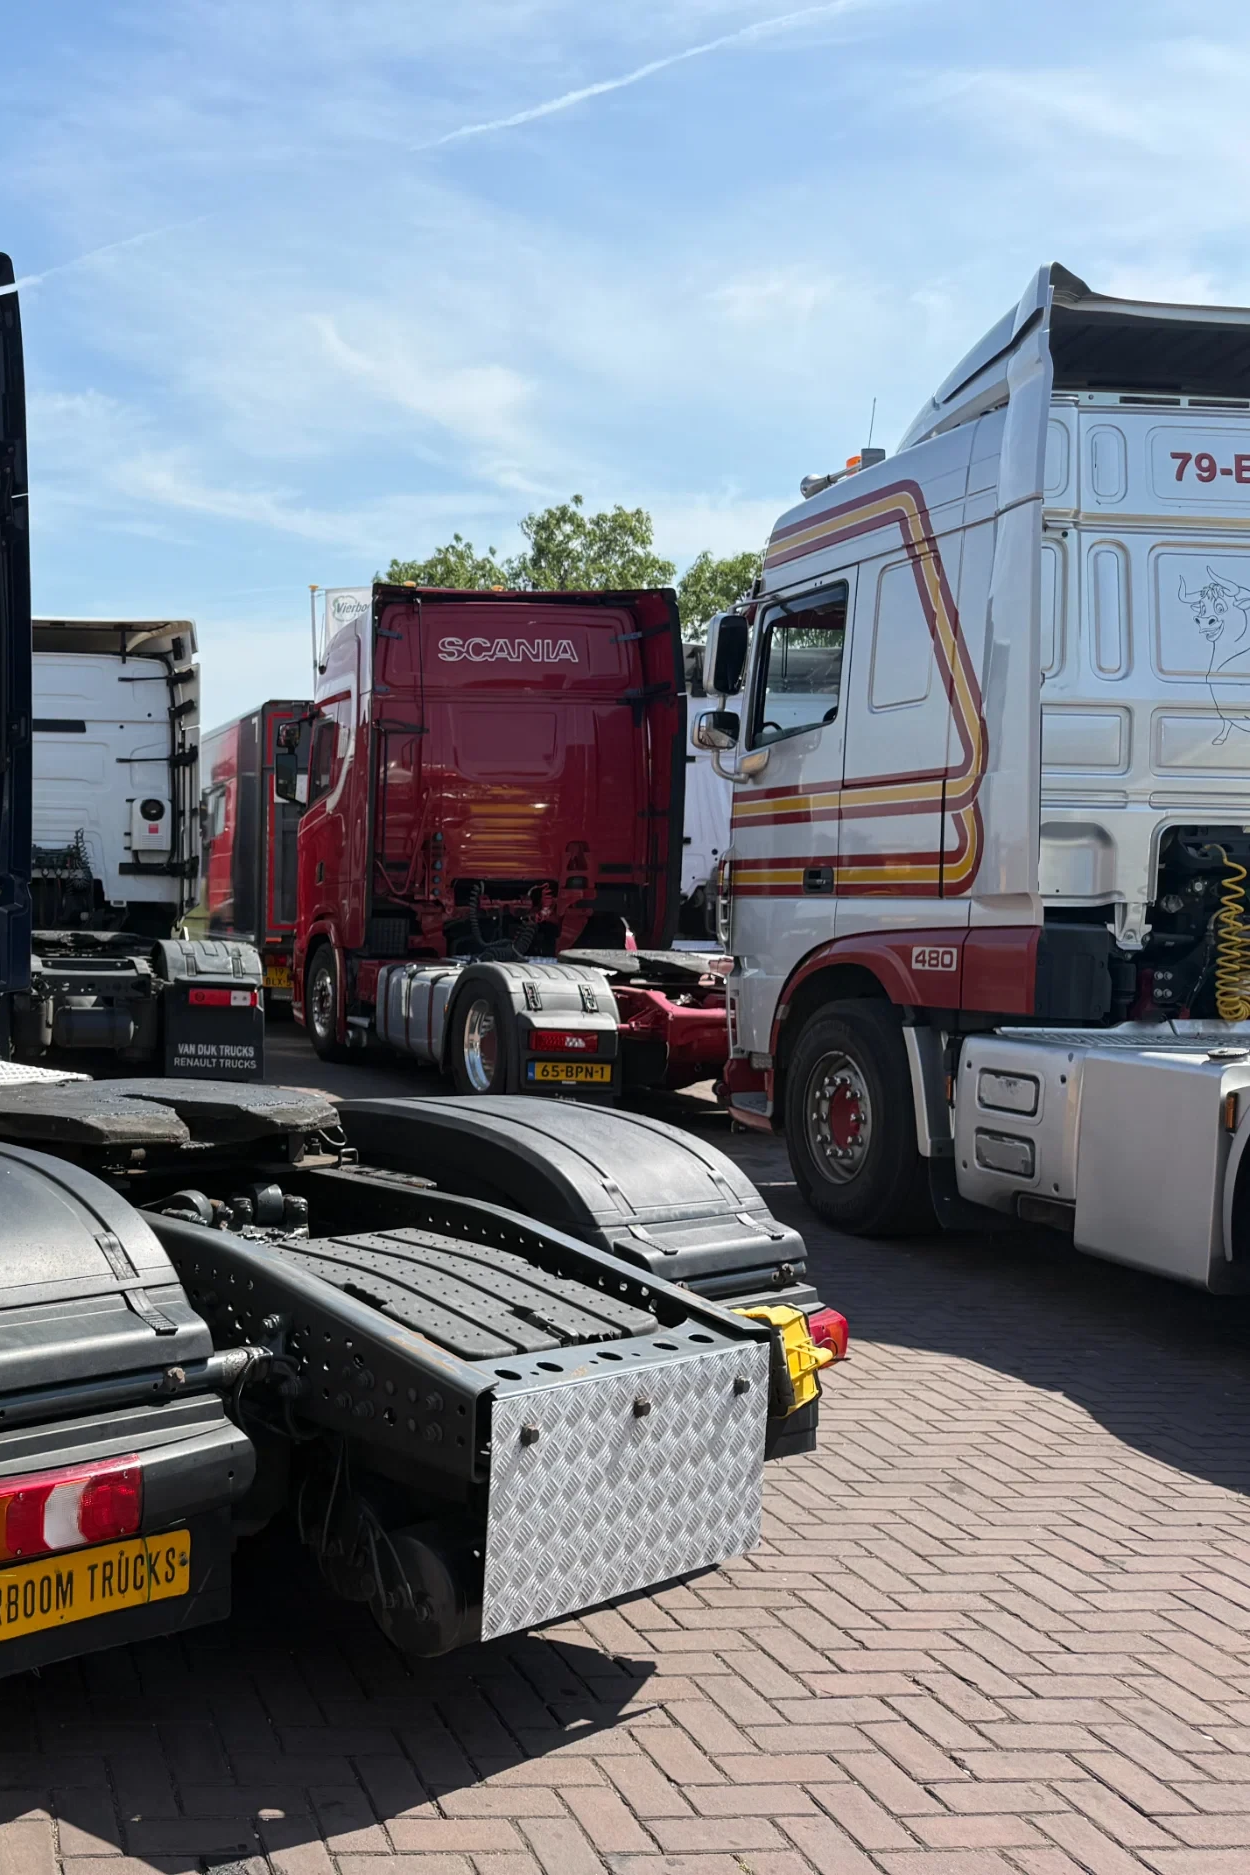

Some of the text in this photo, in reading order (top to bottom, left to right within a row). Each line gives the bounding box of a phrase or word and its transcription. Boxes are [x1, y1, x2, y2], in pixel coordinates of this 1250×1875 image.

[438, 637, 579, 663] SCANIA
[914, 948, 954, 969] 480
[178, 1043, 254, 1058] VAN DIJK TRUCKS
[174, 1057, 257, 1069] RENAULT TRUCKS
[541, 1064, 604, 1079] 65-BPN-1
[87, 1547, 176, 1602] TRUCKS
